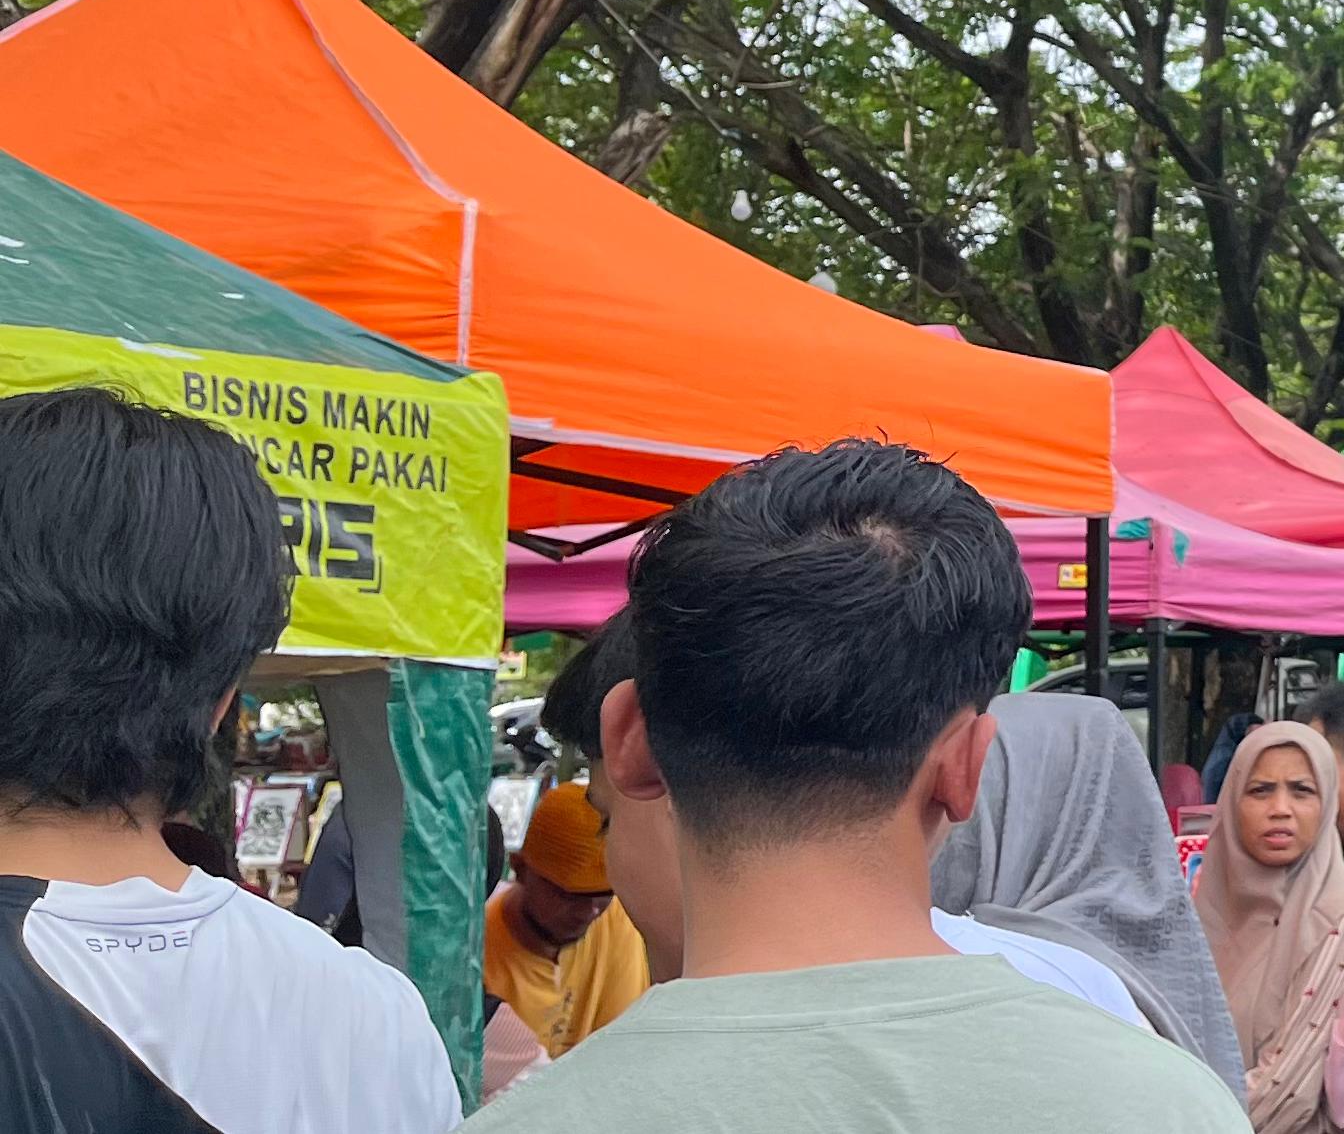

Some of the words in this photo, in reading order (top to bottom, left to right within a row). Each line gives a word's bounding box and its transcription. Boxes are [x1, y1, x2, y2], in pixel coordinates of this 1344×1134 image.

[183, 371, 308, 424] BISNIS
[322, 389, 431, 439] MAKIN
[348, 445, 448, 492] PAKAI
[277, 495, 375, 580] RIS
[85, 930, 193, 954] SPYDE
